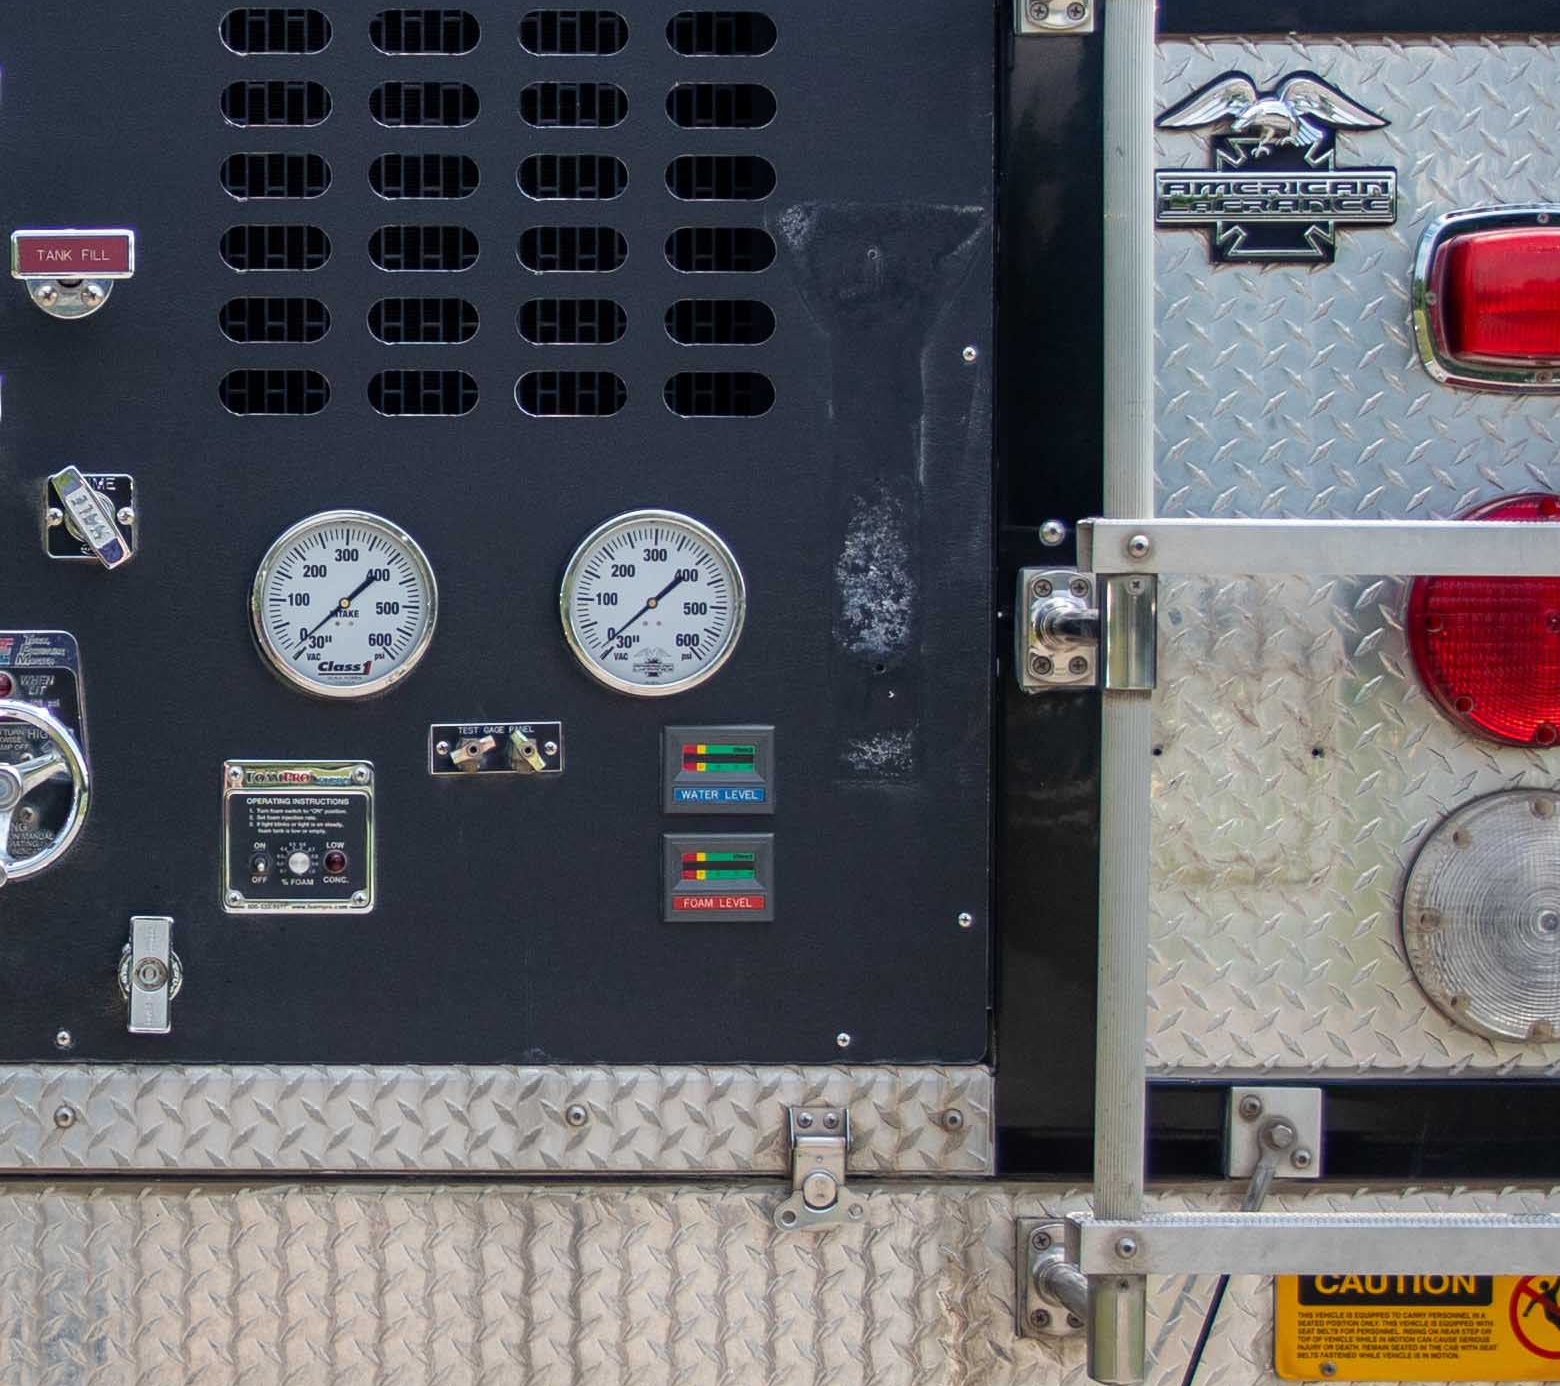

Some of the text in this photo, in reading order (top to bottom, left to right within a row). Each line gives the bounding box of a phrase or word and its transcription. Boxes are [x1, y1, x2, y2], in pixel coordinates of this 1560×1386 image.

[1161, 181, 1390, 196] AMERICAN
[36, 249, 110, 262] TANK FILL
[335, 549, 359, 562] 300
[643, 548, 667, 562] 300
[302, 564, 327, 578] 200
[367, 568, 390, 582] 400
[611, 564, 635, 578] 200
[674, 568, 698, 582] 400
[287, 593, 310, 606] 100
[596, 592, 618, 606] 100
[375, 601, 399, 615] 500
[683, 602, 707, 615] 500
[368, 633, 392, 646] 600
[675, 633, 699, 647] 600
[306, 652, 321, 661] VAC
[614, 652, 628, 661] VAC
[20, 675, 55, 686] WHEN
[28, 685, 47, 696] LIT
[458, 726, 480, 734] TEST
[483, 725, 505, 734] GAGE
[680, 789, 758, 800] WATER LEVEL
[246, 797, 350, 806] OPERATING INSTRUCTIONS
[253, 841, 267, 850] ON
[326, 841, 345, 849] LOW
[251, 875, 267, 884] OFF
[290, 878, 315, 886] FOAM
[683, 897, 753, 909] FOAM LEVEL
[1314, 1275, 1476, 1295] CAUTION
